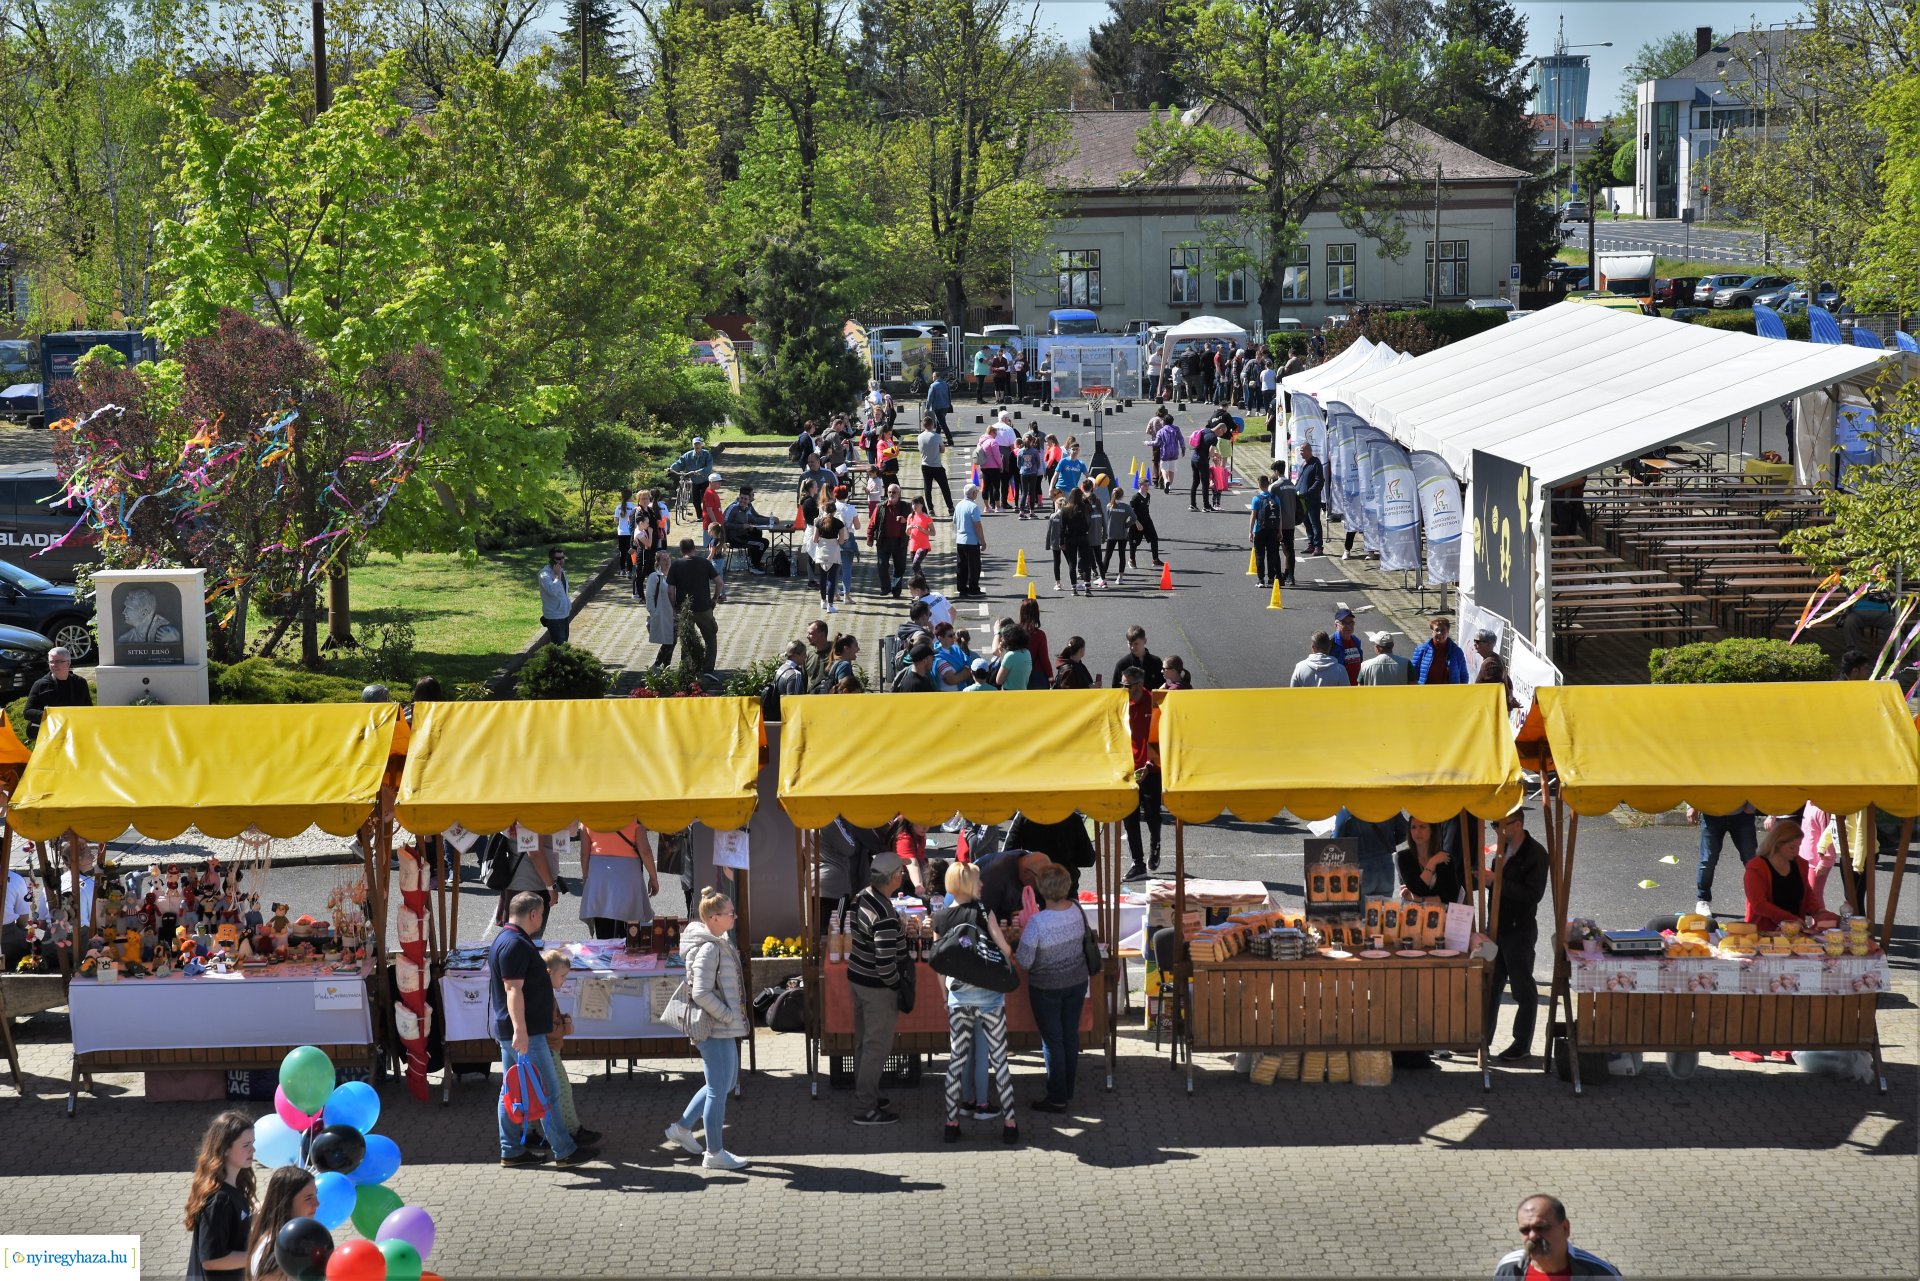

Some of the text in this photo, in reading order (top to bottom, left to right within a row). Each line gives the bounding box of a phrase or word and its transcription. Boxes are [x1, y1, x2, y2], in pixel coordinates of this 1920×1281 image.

[0, 533, 63, 547] BLADE
[228, 1070, 250, 1082] LUE
[228, 1080, 250, 1095] AG
